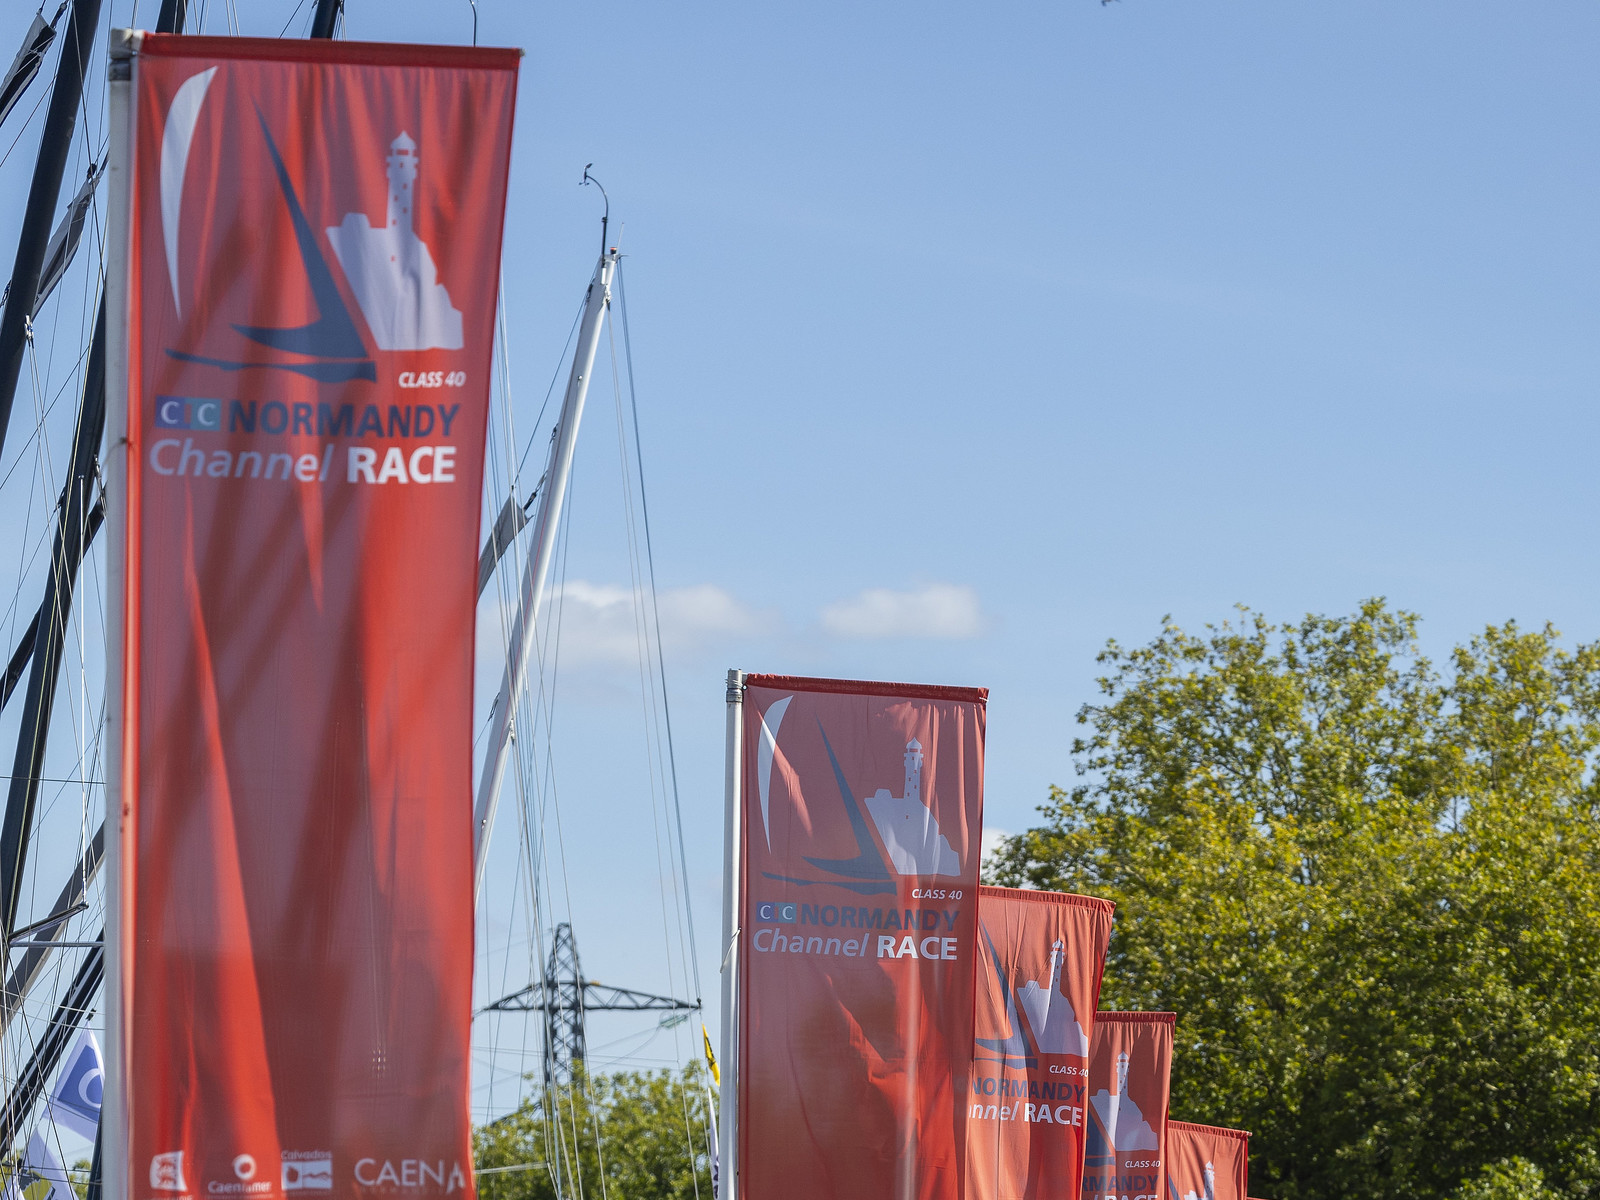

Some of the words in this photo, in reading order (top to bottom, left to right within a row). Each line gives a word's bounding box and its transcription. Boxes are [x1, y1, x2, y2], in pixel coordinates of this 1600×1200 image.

[399, 371, 442, 388] CLASS
[445, 372, 466, 387] 40
[229, 401, 460, 438] NORMANDY
[150, 438, 334, 482] Channel
[347, 446, 457, 484] RACE
[911, 888, 945, 900] CLASS
[949, 888, 963, 900] 40
[801, 903, 960, 932] NORMANDY
[752, 928, 870, 957] Channel
[876, 935, 958, 960] RACE
[1049, 1065, 1077, 1076] CLASS
[1023, 1102, 1083, 1127] RACE
[1125, 1160, 1150, 1168] CLASS
[1151, 1160, 1161, 1168] 40
[1081, 1175, 1159, 1193] RMANDY
